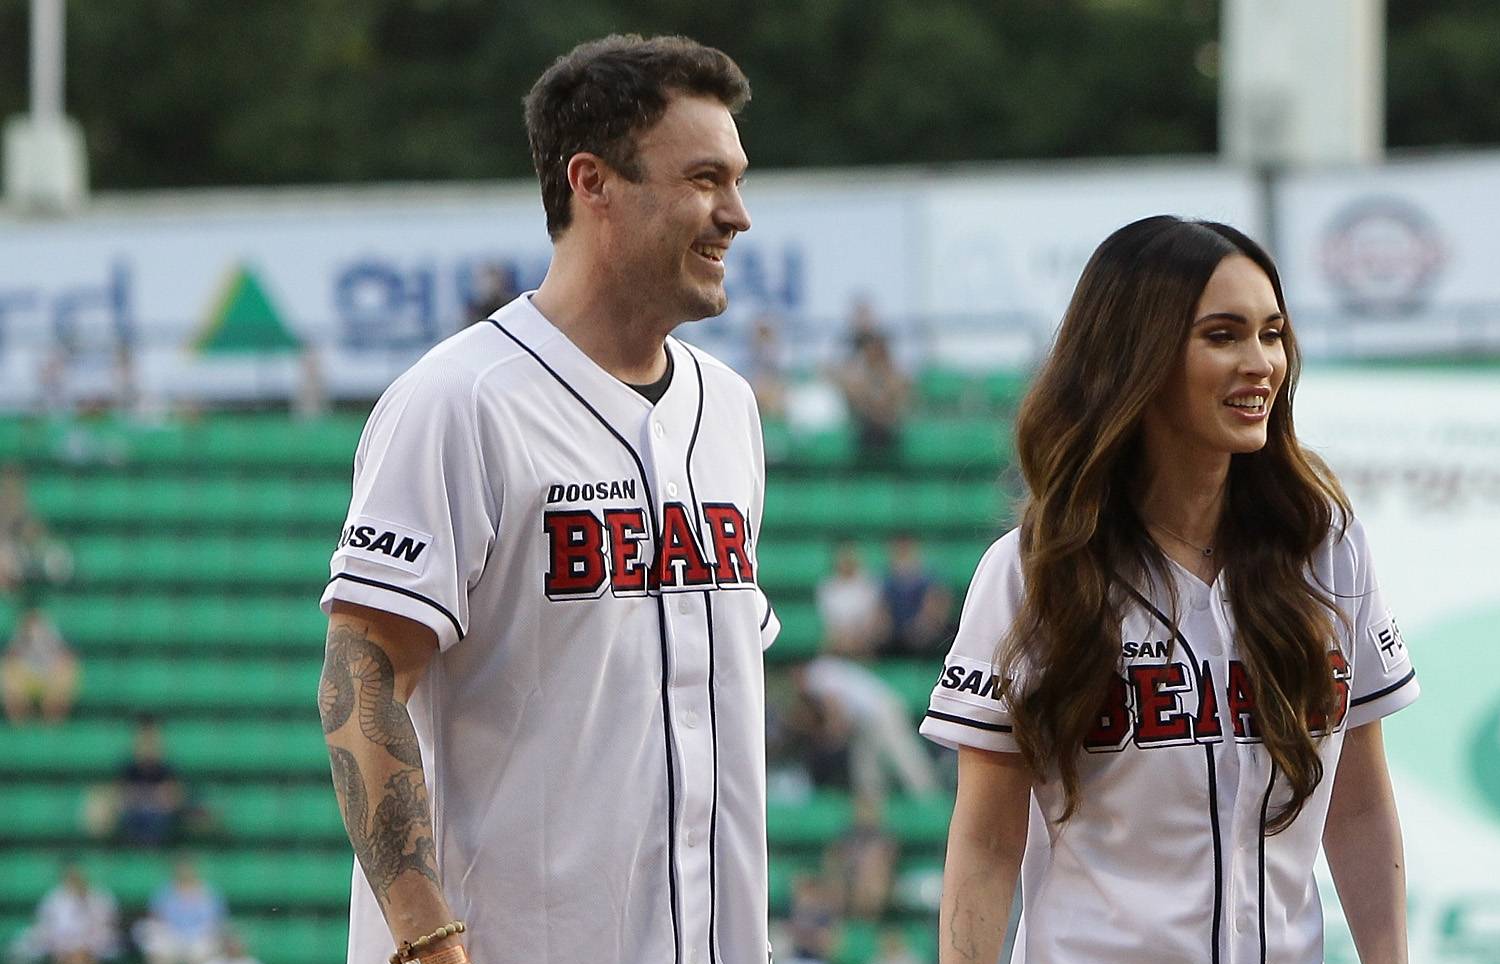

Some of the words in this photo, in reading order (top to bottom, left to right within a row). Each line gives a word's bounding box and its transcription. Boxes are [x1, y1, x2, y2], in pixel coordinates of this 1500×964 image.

[547, 479, 636, 503] DOOSAN
[543, 502, 757, 601] BEAR
[1123, 641, 1172, 659] SAN
[931, 664, 1012, 701] SAN
[1083, 650, 1351, 753] BEAS
